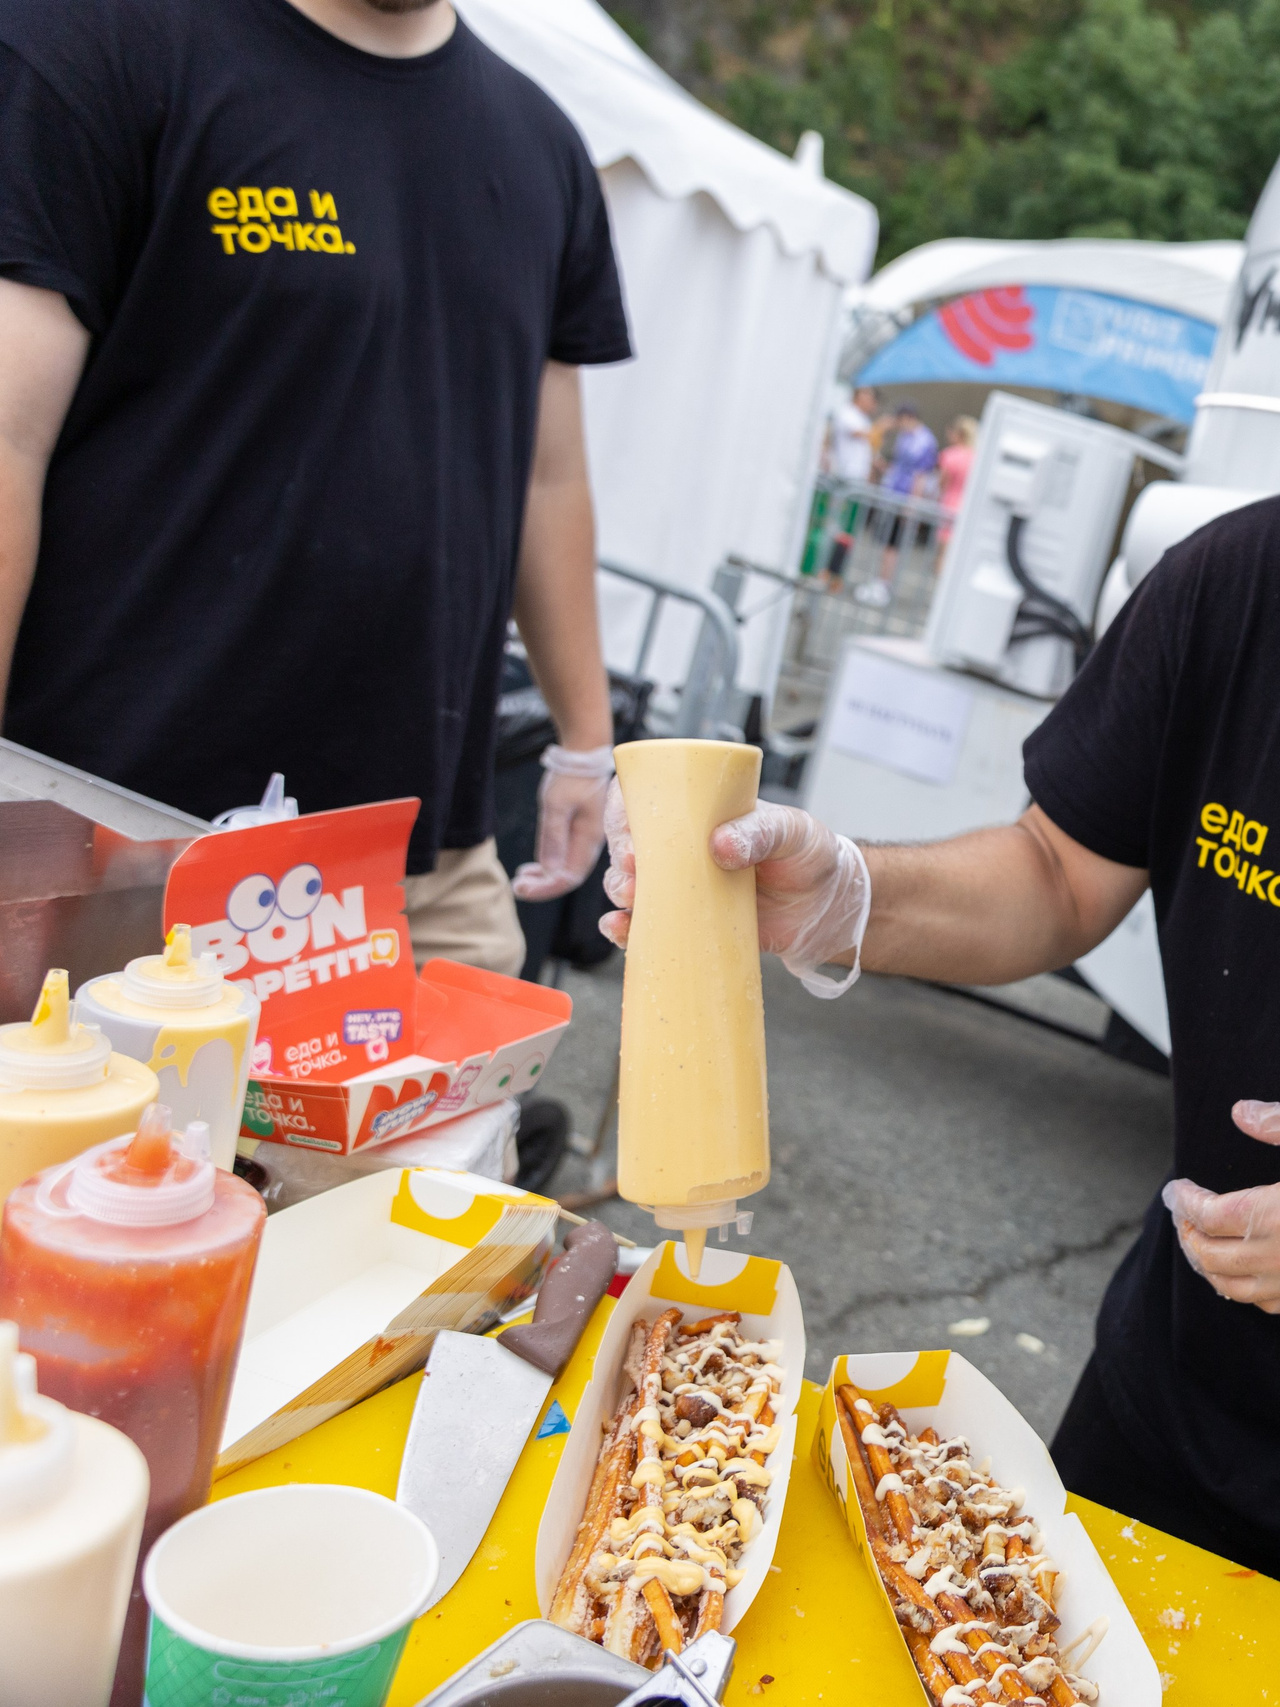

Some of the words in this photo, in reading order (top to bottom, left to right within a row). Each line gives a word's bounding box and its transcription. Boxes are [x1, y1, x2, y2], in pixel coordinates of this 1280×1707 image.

[207, 186, 298, 223] еда
[308, 189, 338, 221] и
[211, 221, 356, 255] точка.
[1200, 802, 1269, 856] еда
[191, 886, 367, 976] BON
[285, 1038, 322, 1063] еда
[325, 1032, 339, 1048] и
[346, 1023, 401, 1042] TASTY
[289, 1049, 348, 1079] точка.
[244, 1106, 316, 1131] точка.
[289, 1097, 305, 1113] и
